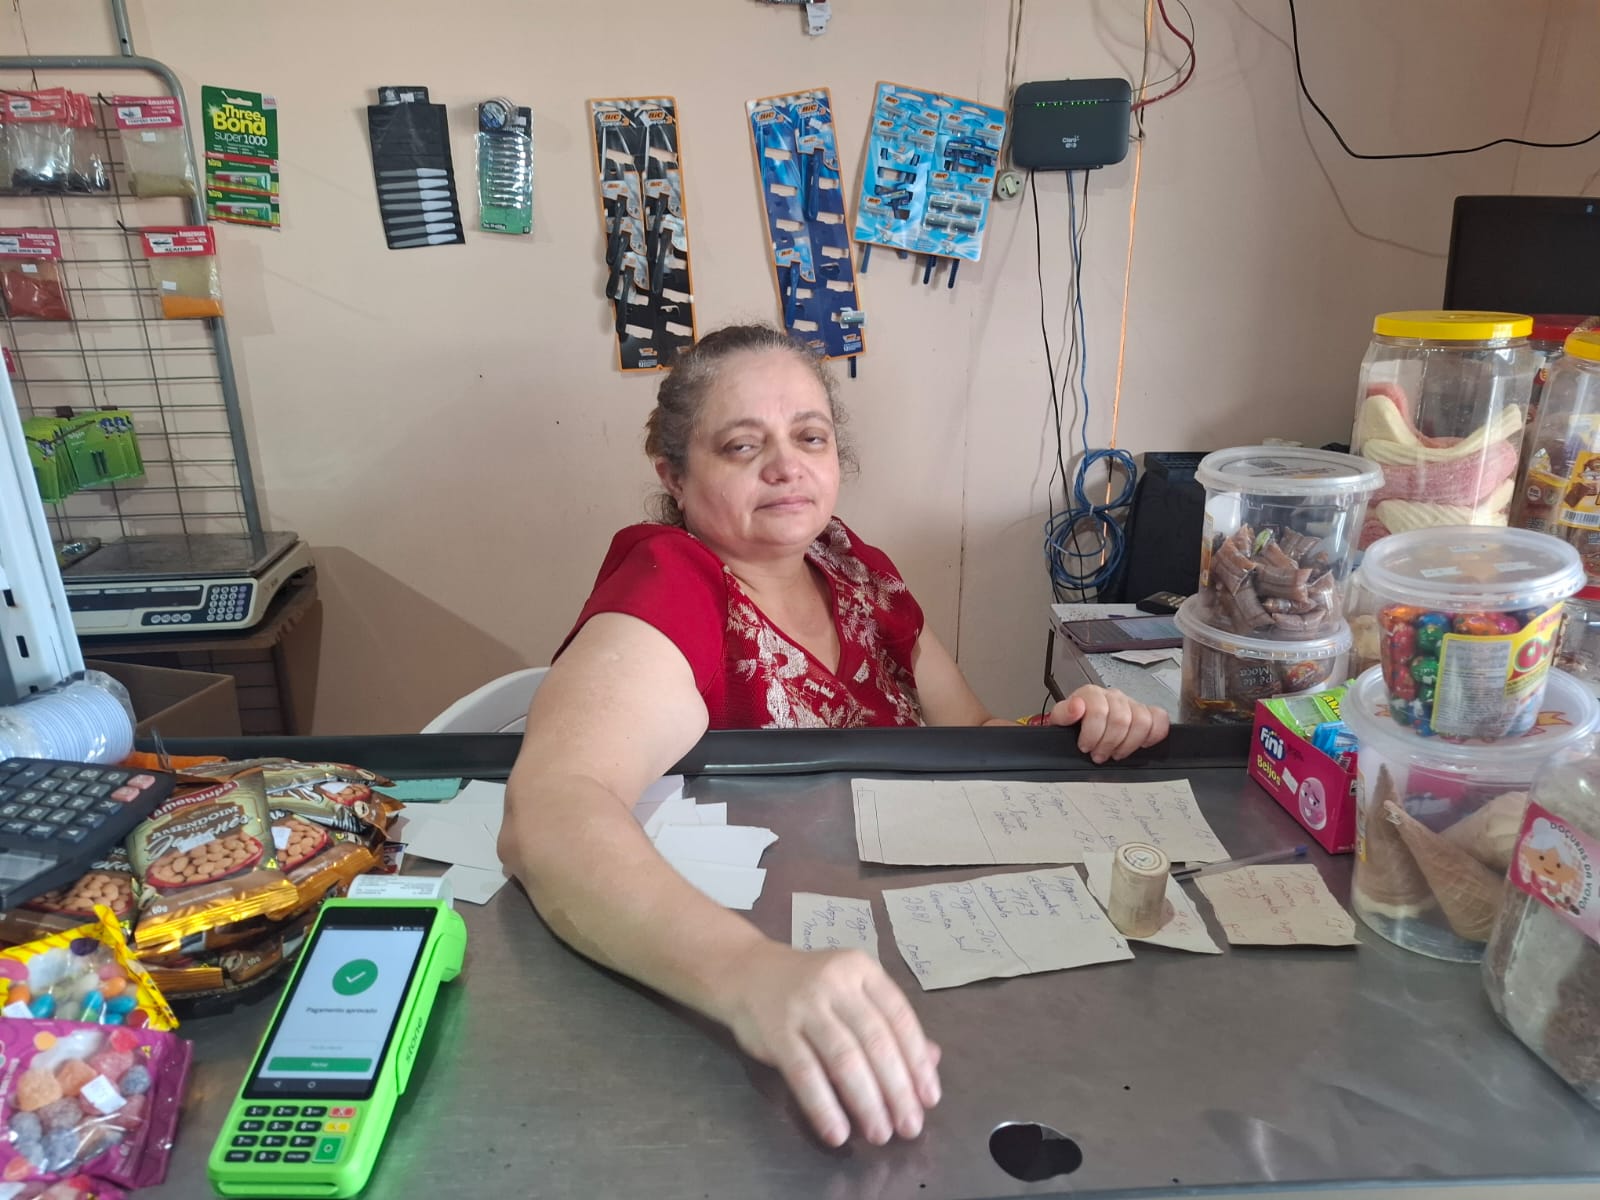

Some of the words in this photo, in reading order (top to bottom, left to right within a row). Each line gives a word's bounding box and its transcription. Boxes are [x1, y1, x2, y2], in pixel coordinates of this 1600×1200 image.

[213, 110, 266, 136] Bond
[222, 104, 261, 122] Three
[1261, 727, 1284, 760] Fini
[1257, 754, 1281, 786] Beijos
[152, 806, 239, 840] AMENDOIM
[1550, 822, 1588, 861] DOÇURAS
[406, 1017, 423, 1062] stone
